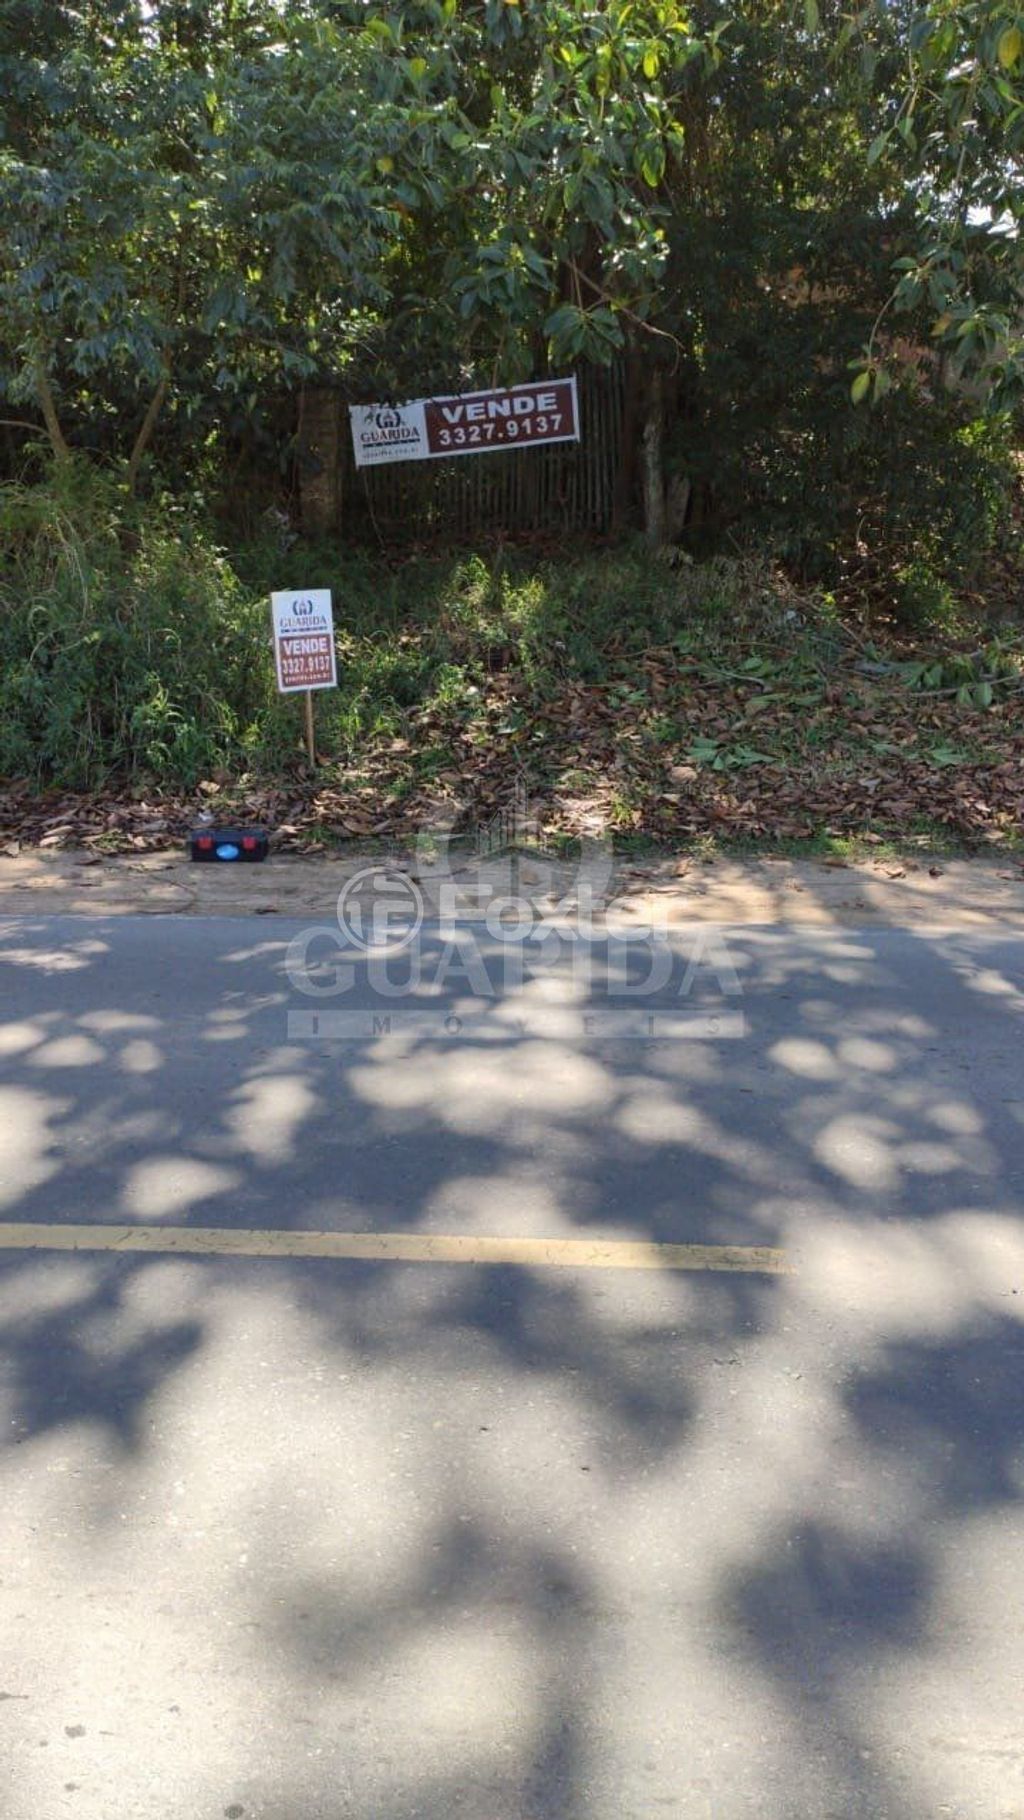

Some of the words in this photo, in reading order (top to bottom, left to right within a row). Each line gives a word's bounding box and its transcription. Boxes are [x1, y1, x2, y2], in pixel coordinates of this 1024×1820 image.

[441, 393, 557, 424] VENDE
[361, 427, 420, 443] GUARIDA
[439, 414, 562, 446] 3327.9137
[283, 637, 328, 656] VENDE
[282, 655, 330, 675] 3327.9137
